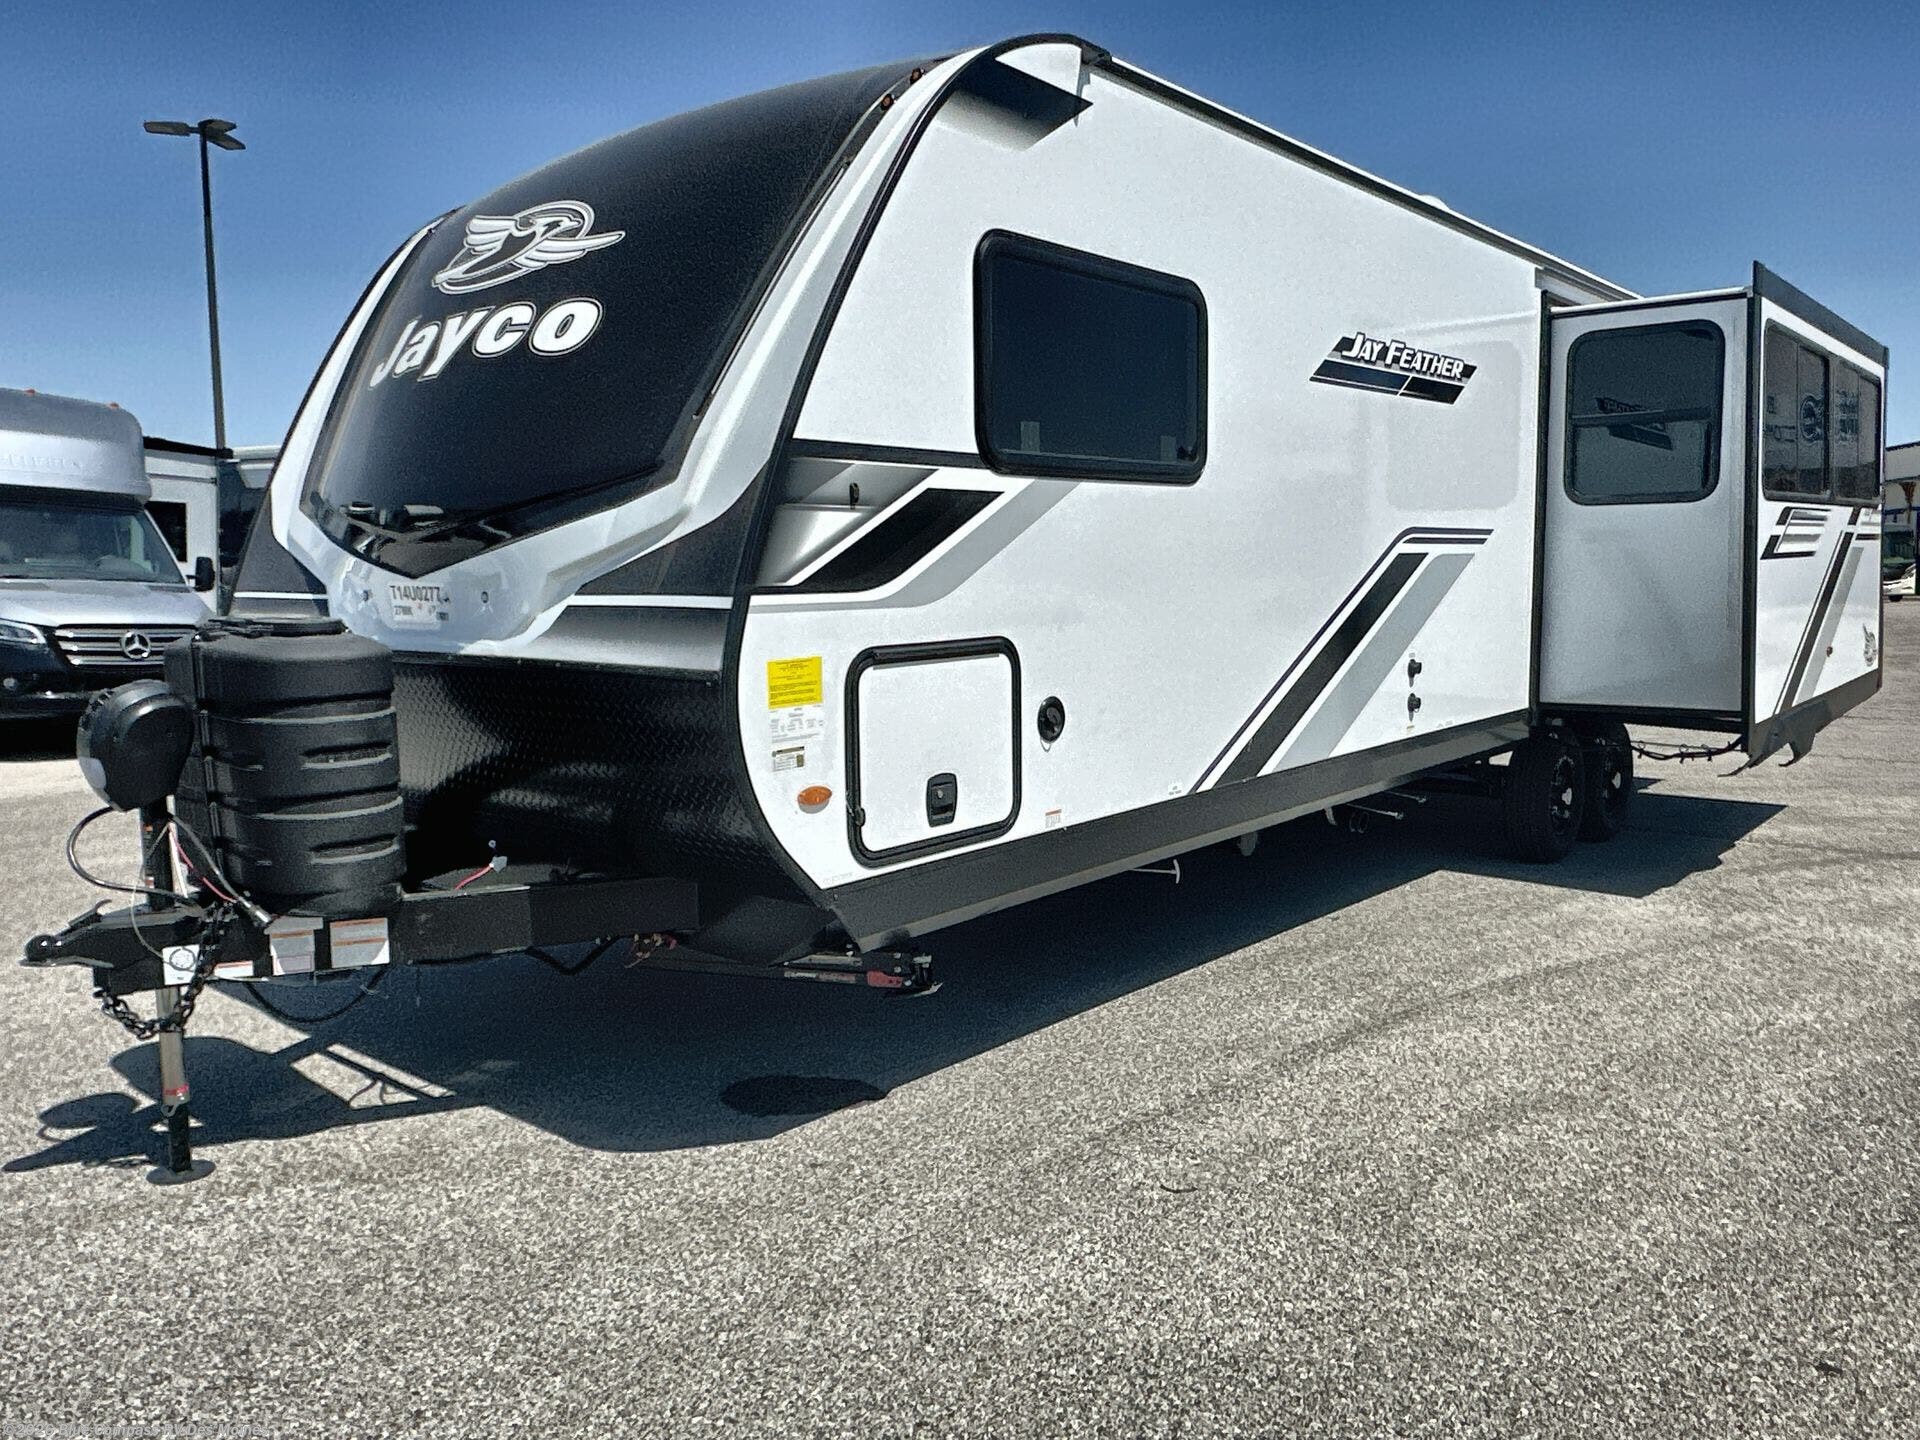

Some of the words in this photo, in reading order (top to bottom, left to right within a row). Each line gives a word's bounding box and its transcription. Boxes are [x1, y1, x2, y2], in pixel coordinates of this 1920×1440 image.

[369, 298, 602, 390] Jayco
[1342, 332, 1385, 363] JAY
[1385, 340, 1465, 379] FEATHER
